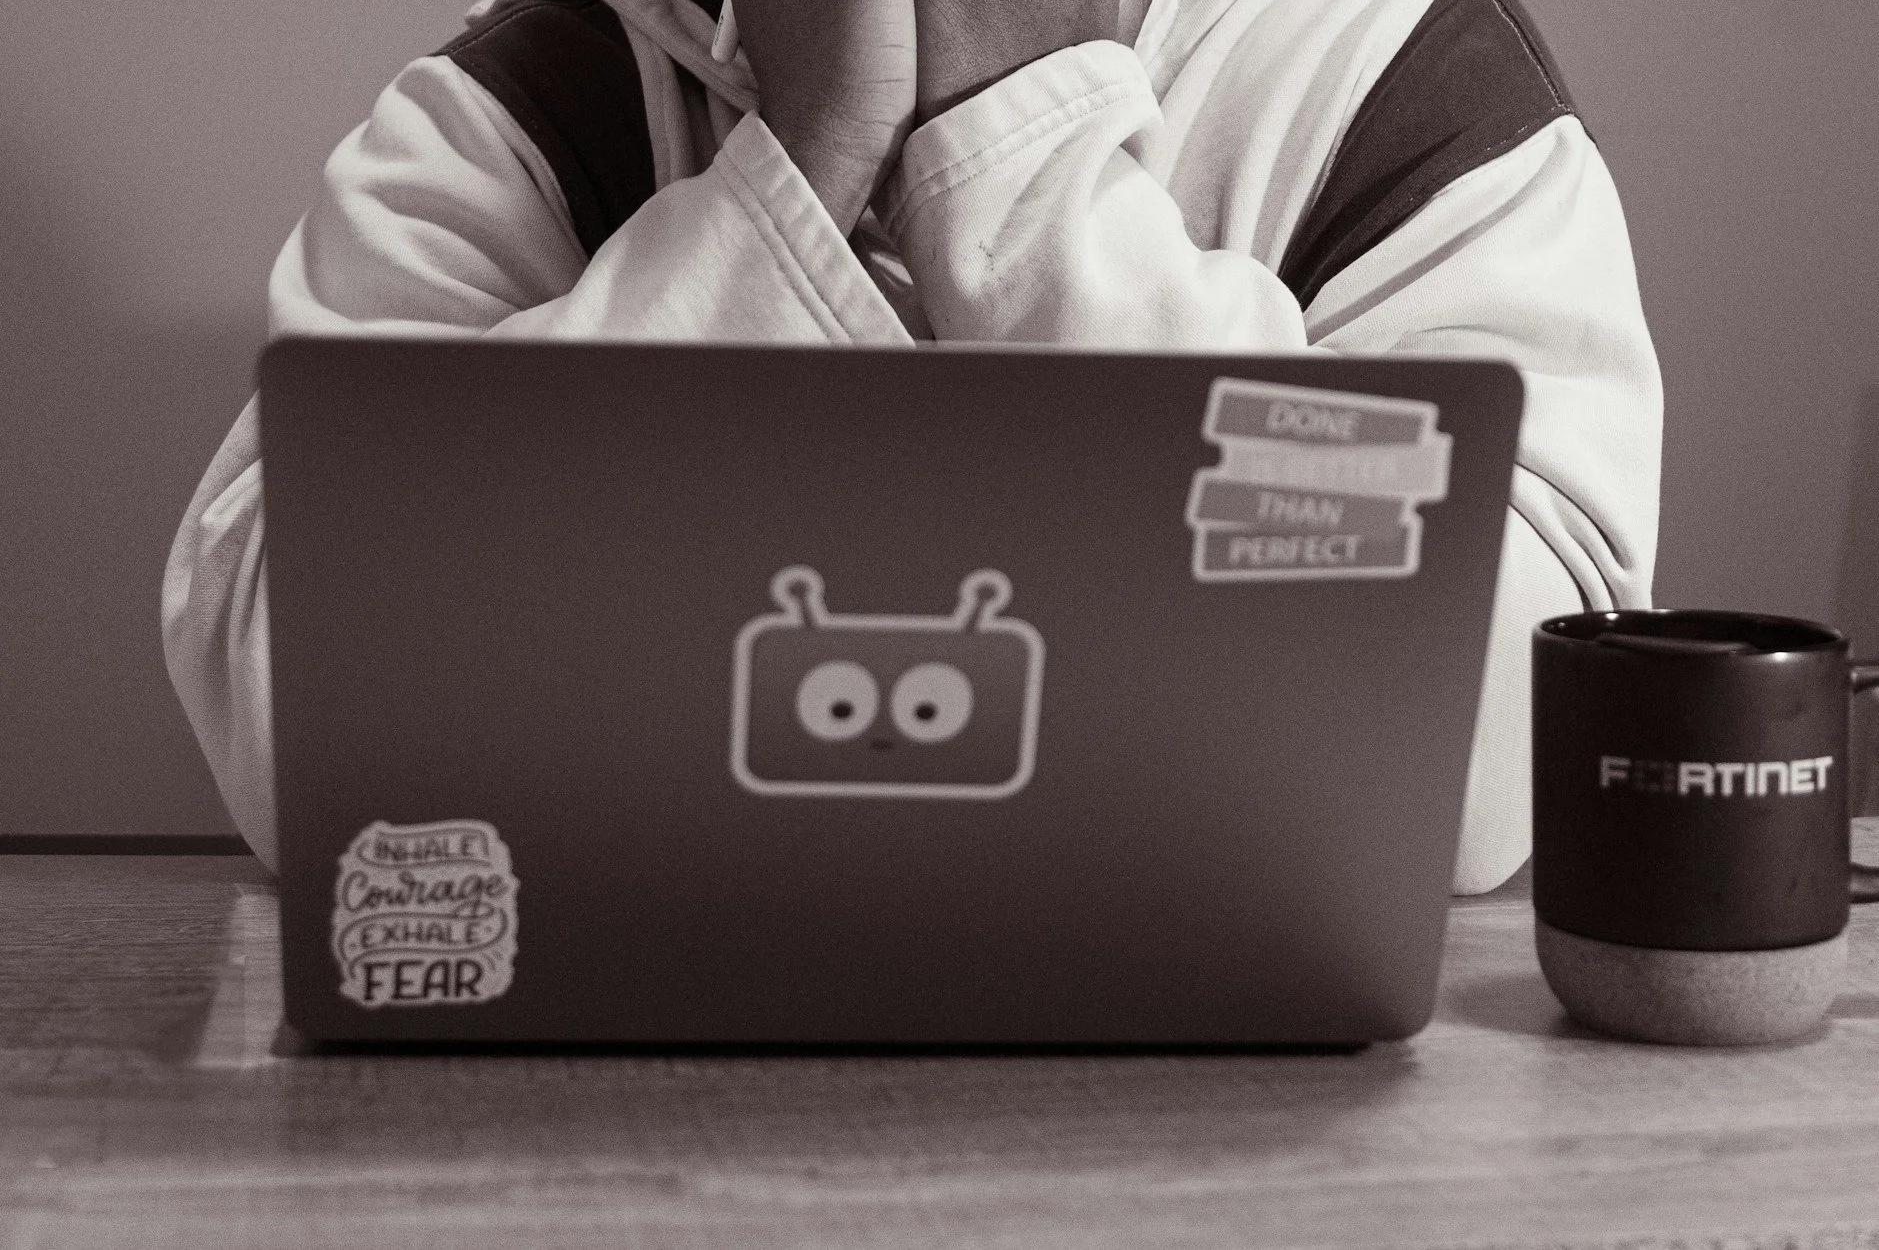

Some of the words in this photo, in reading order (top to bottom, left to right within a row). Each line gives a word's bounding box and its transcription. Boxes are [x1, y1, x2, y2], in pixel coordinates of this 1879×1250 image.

[1266, 402, 1360, 441] DONE
[1257, 490, 1344, 528] THAN
[1229, 534, 1361, 566] PERFECT
[343, 870, 508, 919] Courage
[360, 921, 480, 948] EXHALE
[364, 958, 484, 1000] FEAR
